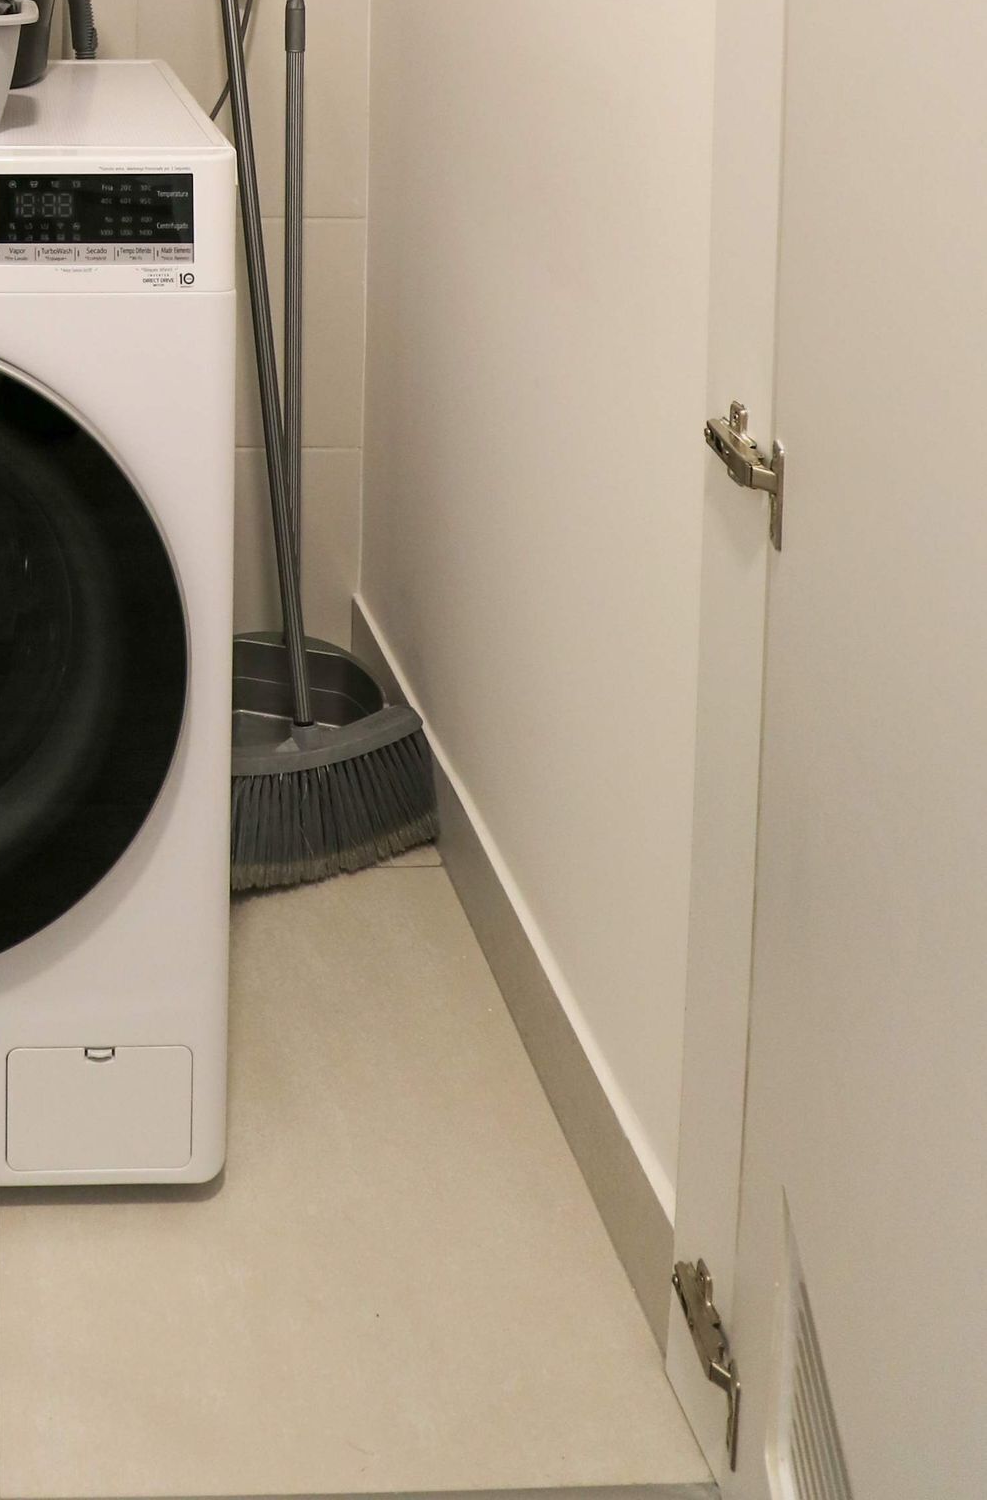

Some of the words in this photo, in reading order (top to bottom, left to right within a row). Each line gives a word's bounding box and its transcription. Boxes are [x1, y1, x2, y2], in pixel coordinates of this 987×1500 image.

[156, 190, 189, 198] Temperatura
[156, 222, 189, 231] Centrifugado
[179, 272, 195, 285] 10
